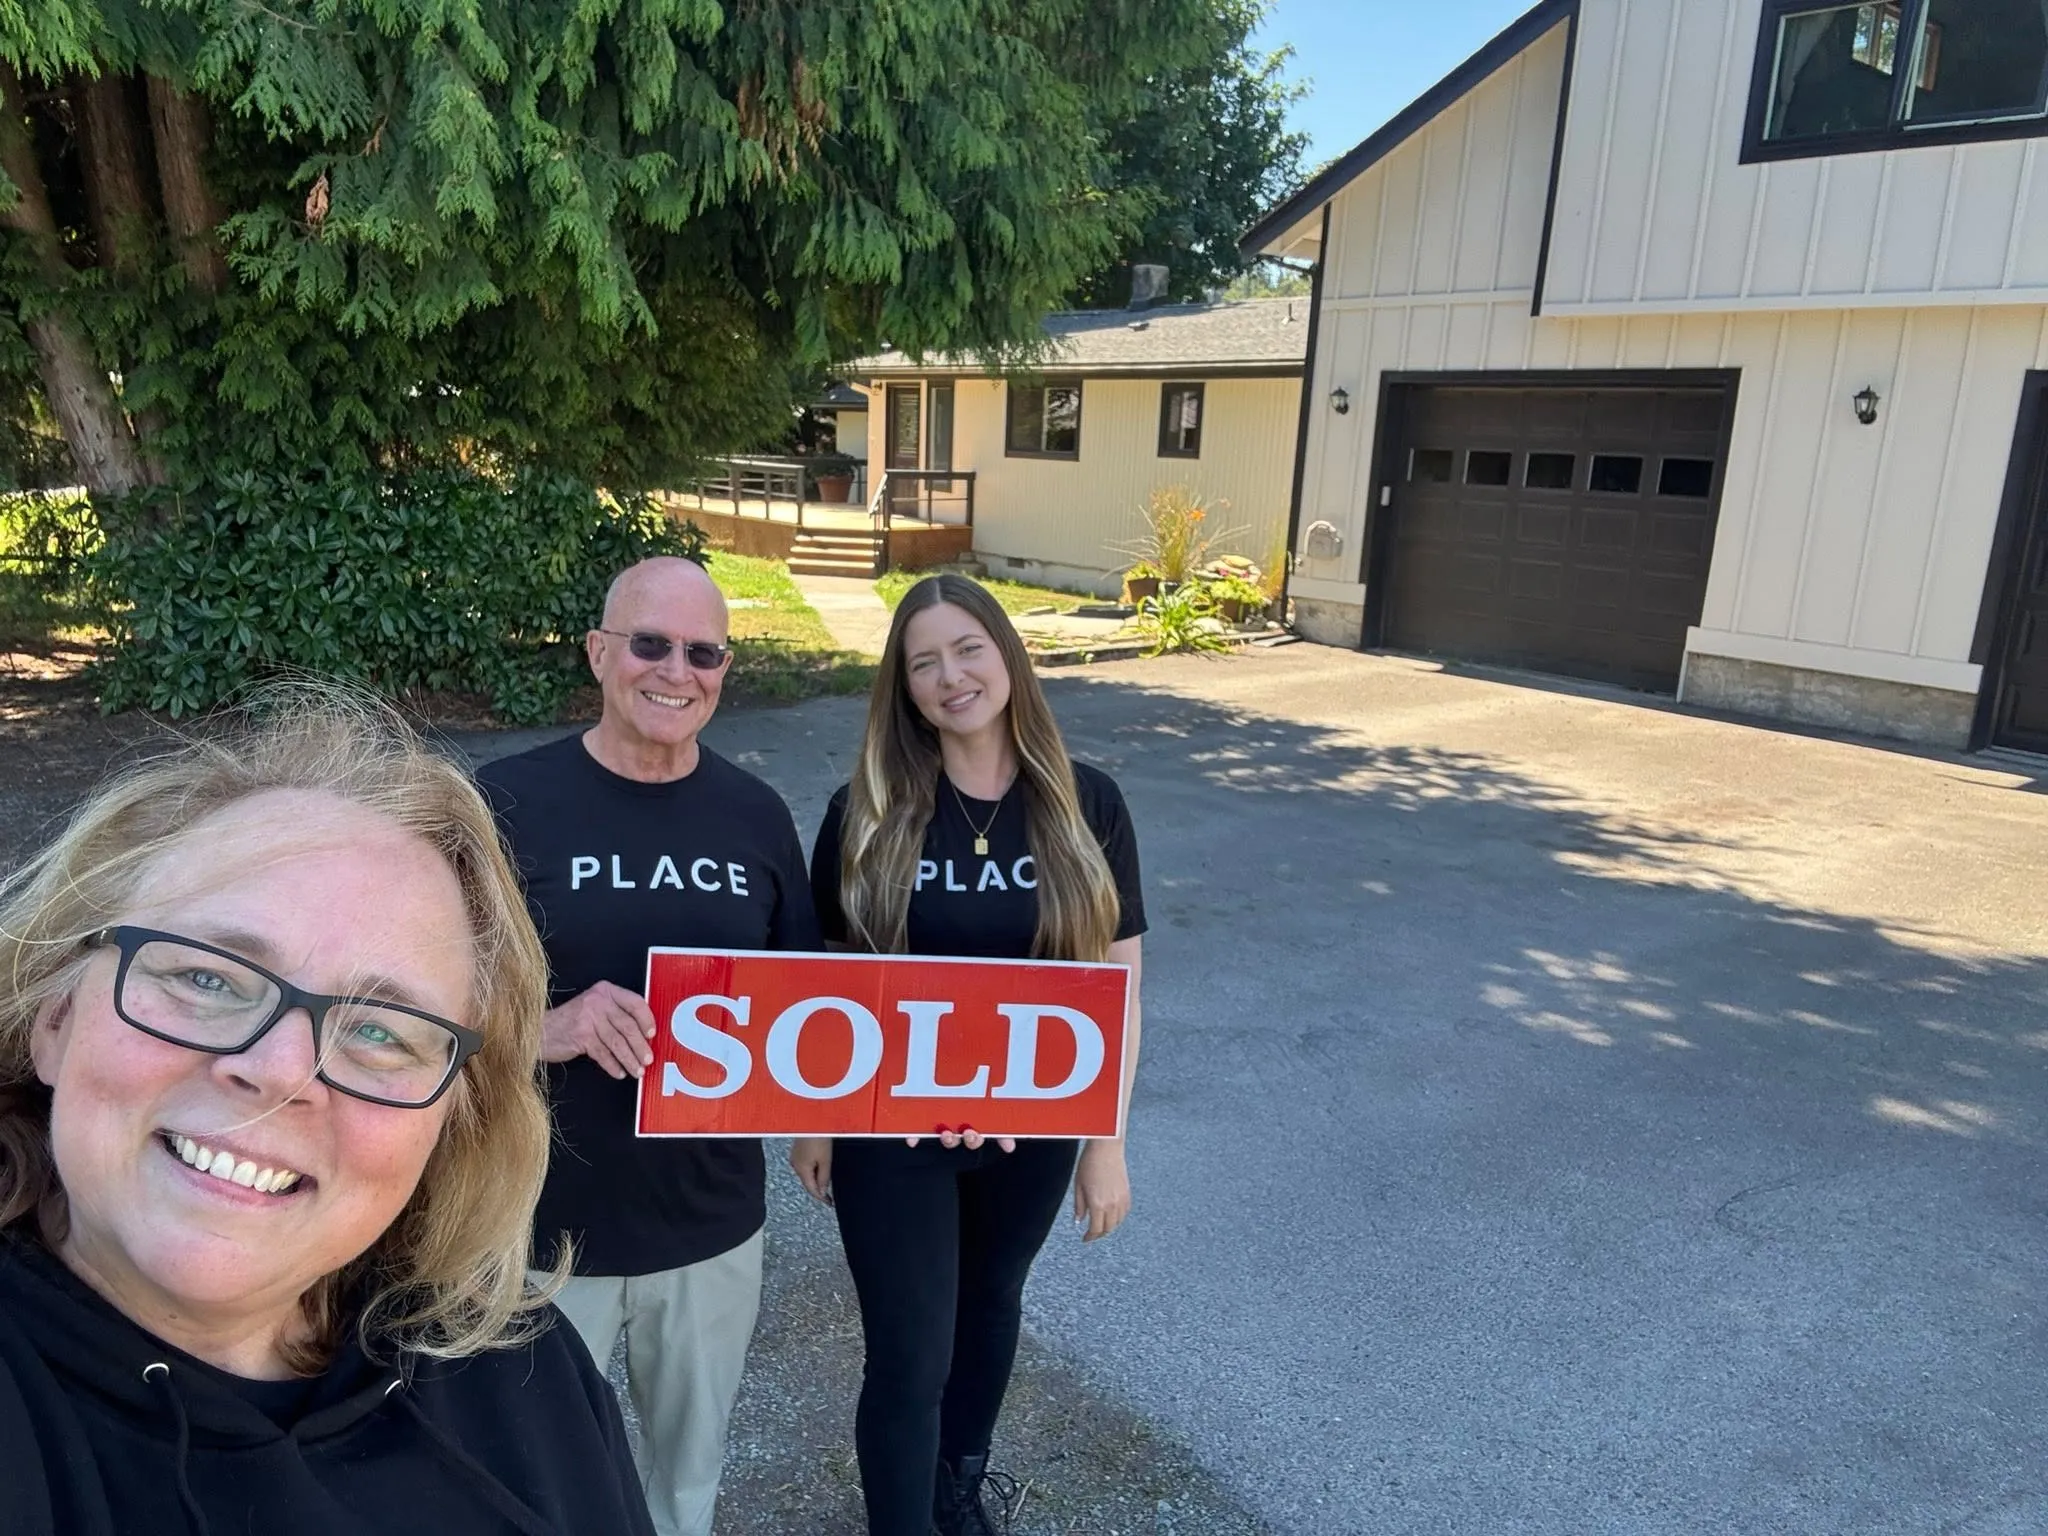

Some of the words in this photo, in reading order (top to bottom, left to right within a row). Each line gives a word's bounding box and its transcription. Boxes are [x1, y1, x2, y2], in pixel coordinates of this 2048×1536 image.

[571, 854, 749, 897] PLACE
[914, 855, 1038, 892] PLAC
[661, 994, 1105, 1100] SOLD
